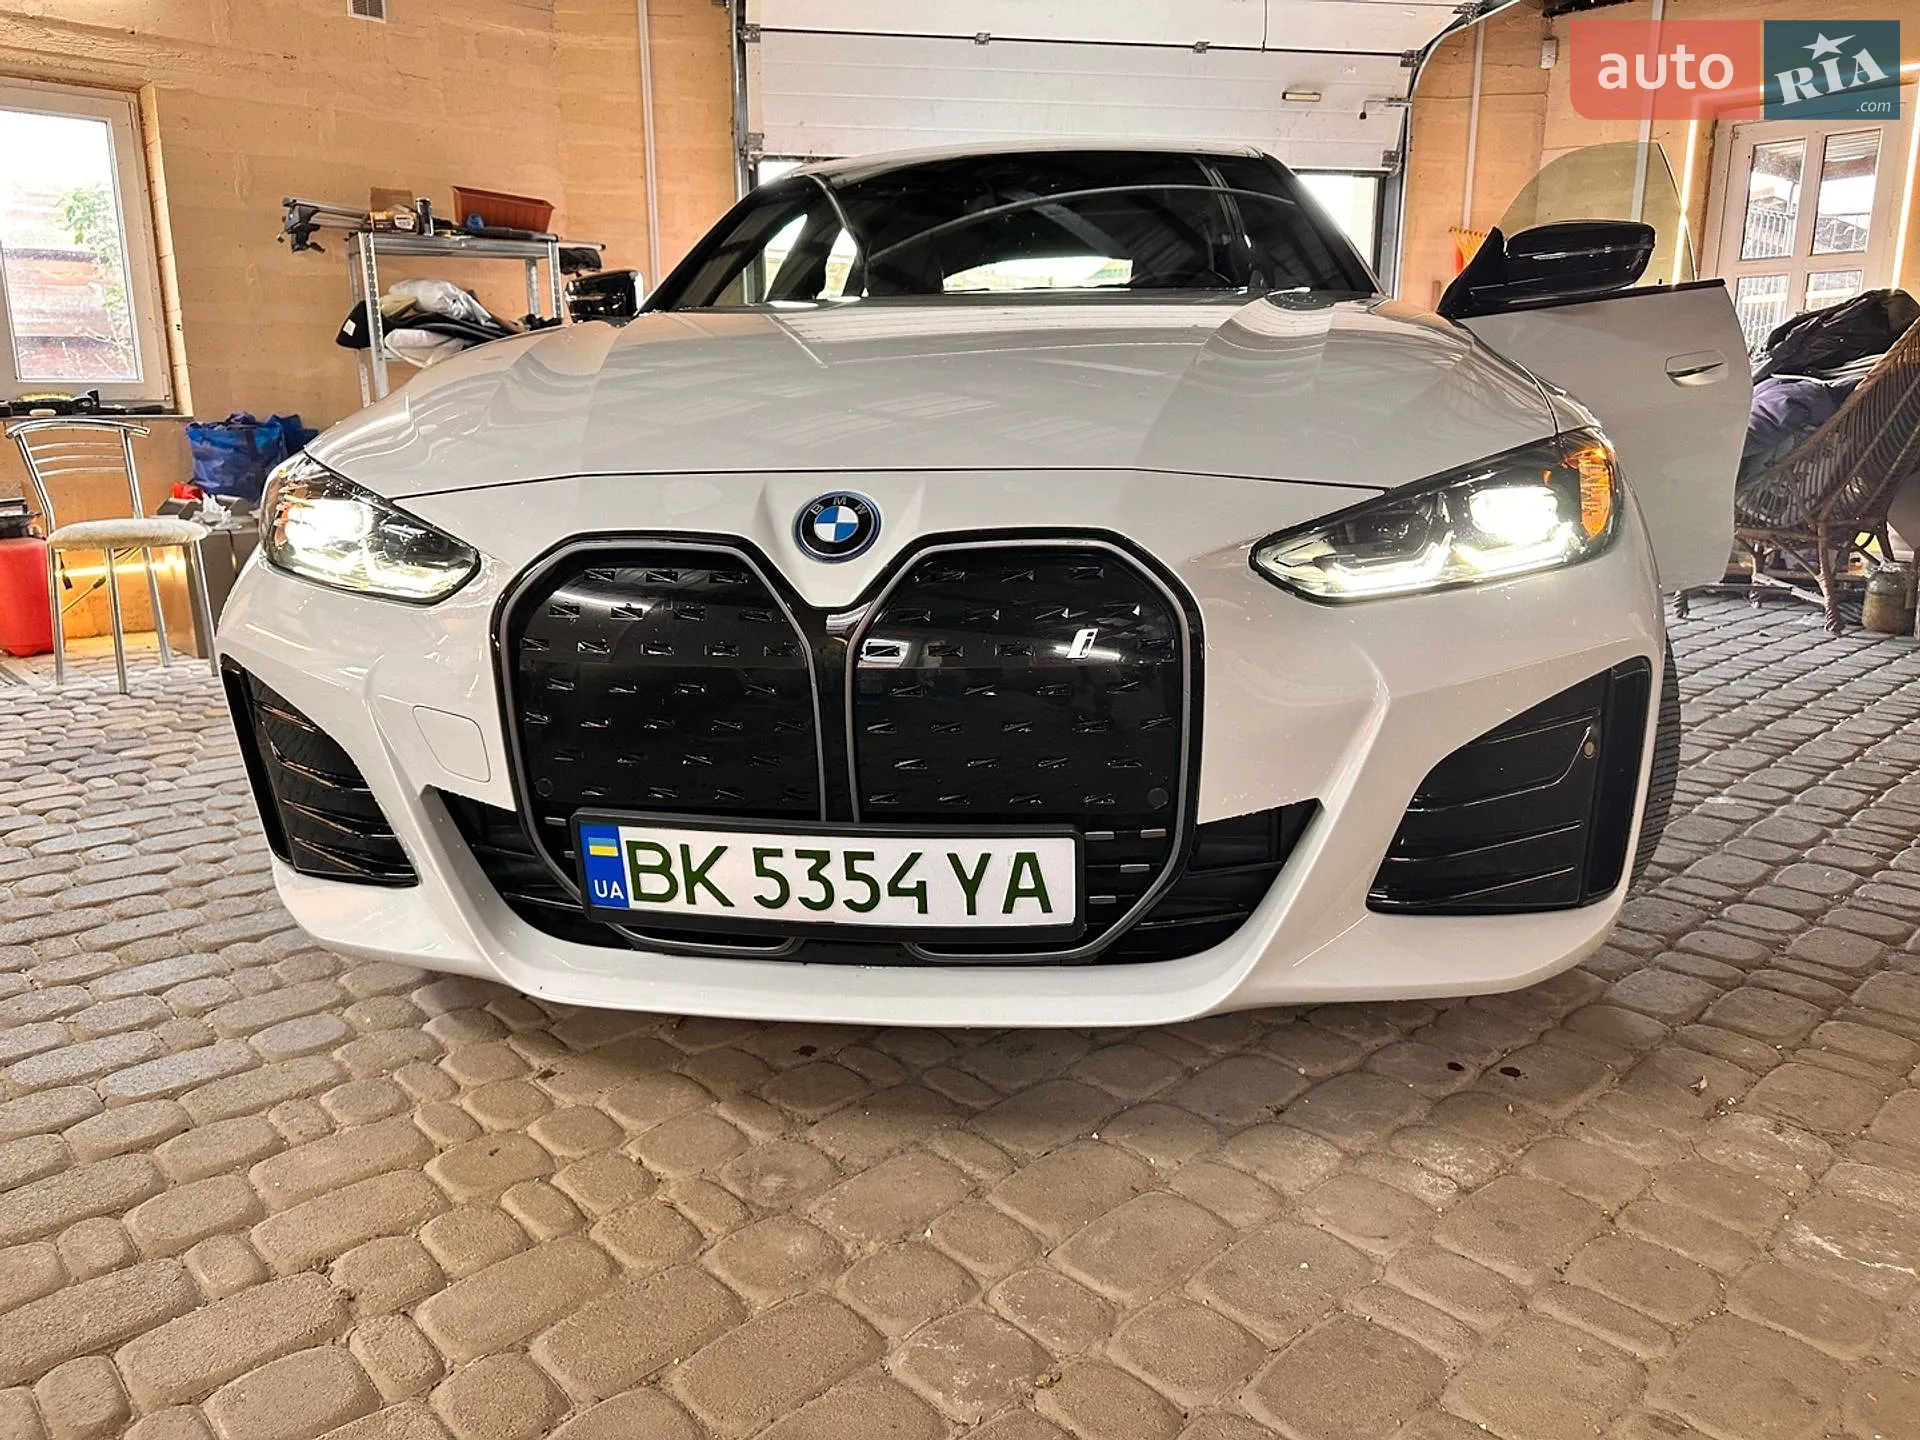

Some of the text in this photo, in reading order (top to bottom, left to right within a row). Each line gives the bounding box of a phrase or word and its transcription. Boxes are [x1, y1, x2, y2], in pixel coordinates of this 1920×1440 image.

[810, 496, 869, 516] BMW
[625, 839, 1054, 916] BK 5354 YA
[594, 879, 625, 900] UA
